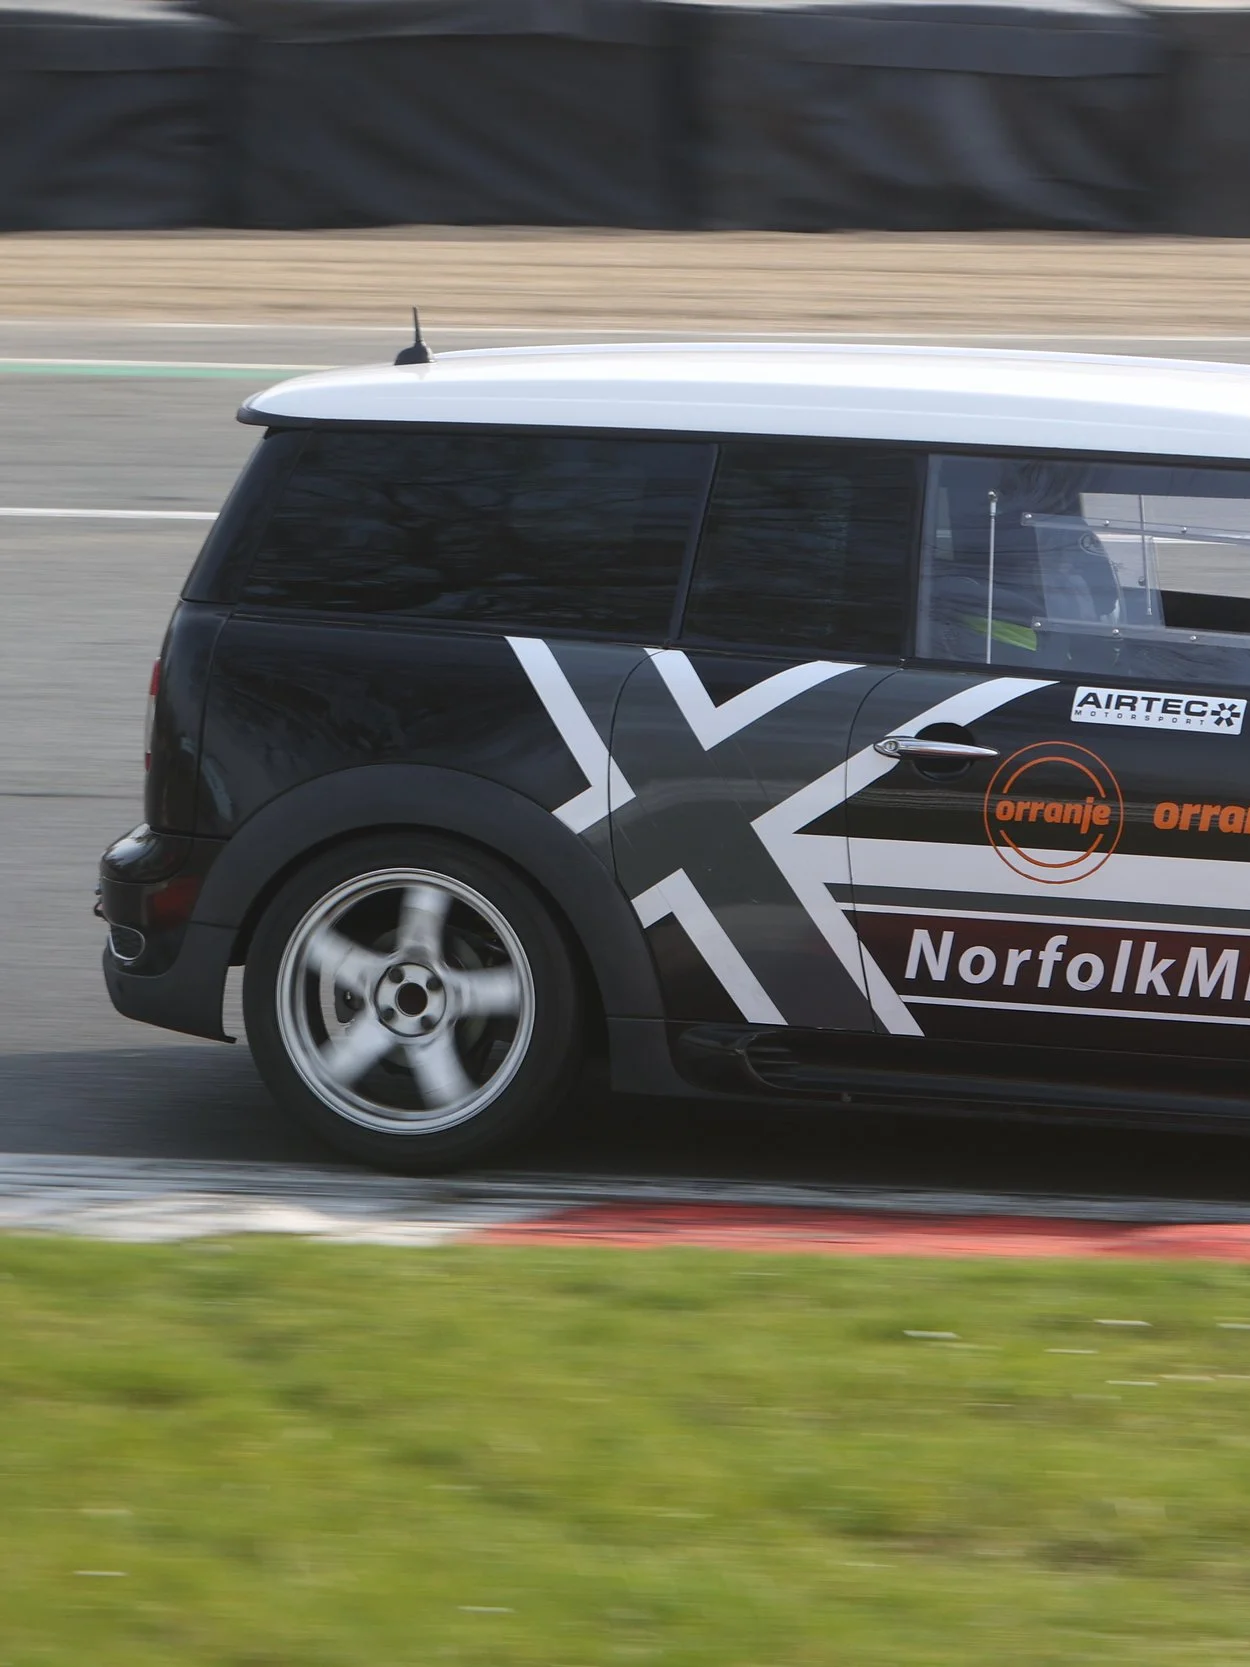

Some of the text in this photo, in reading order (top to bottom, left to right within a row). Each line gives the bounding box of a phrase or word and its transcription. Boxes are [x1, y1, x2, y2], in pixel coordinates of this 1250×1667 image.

[1074, 709, 1205, 726] MOTORSPORT
[1077, 692, 1209, 718] AIRTEC
[995, 796, 1111, 834] orranje
